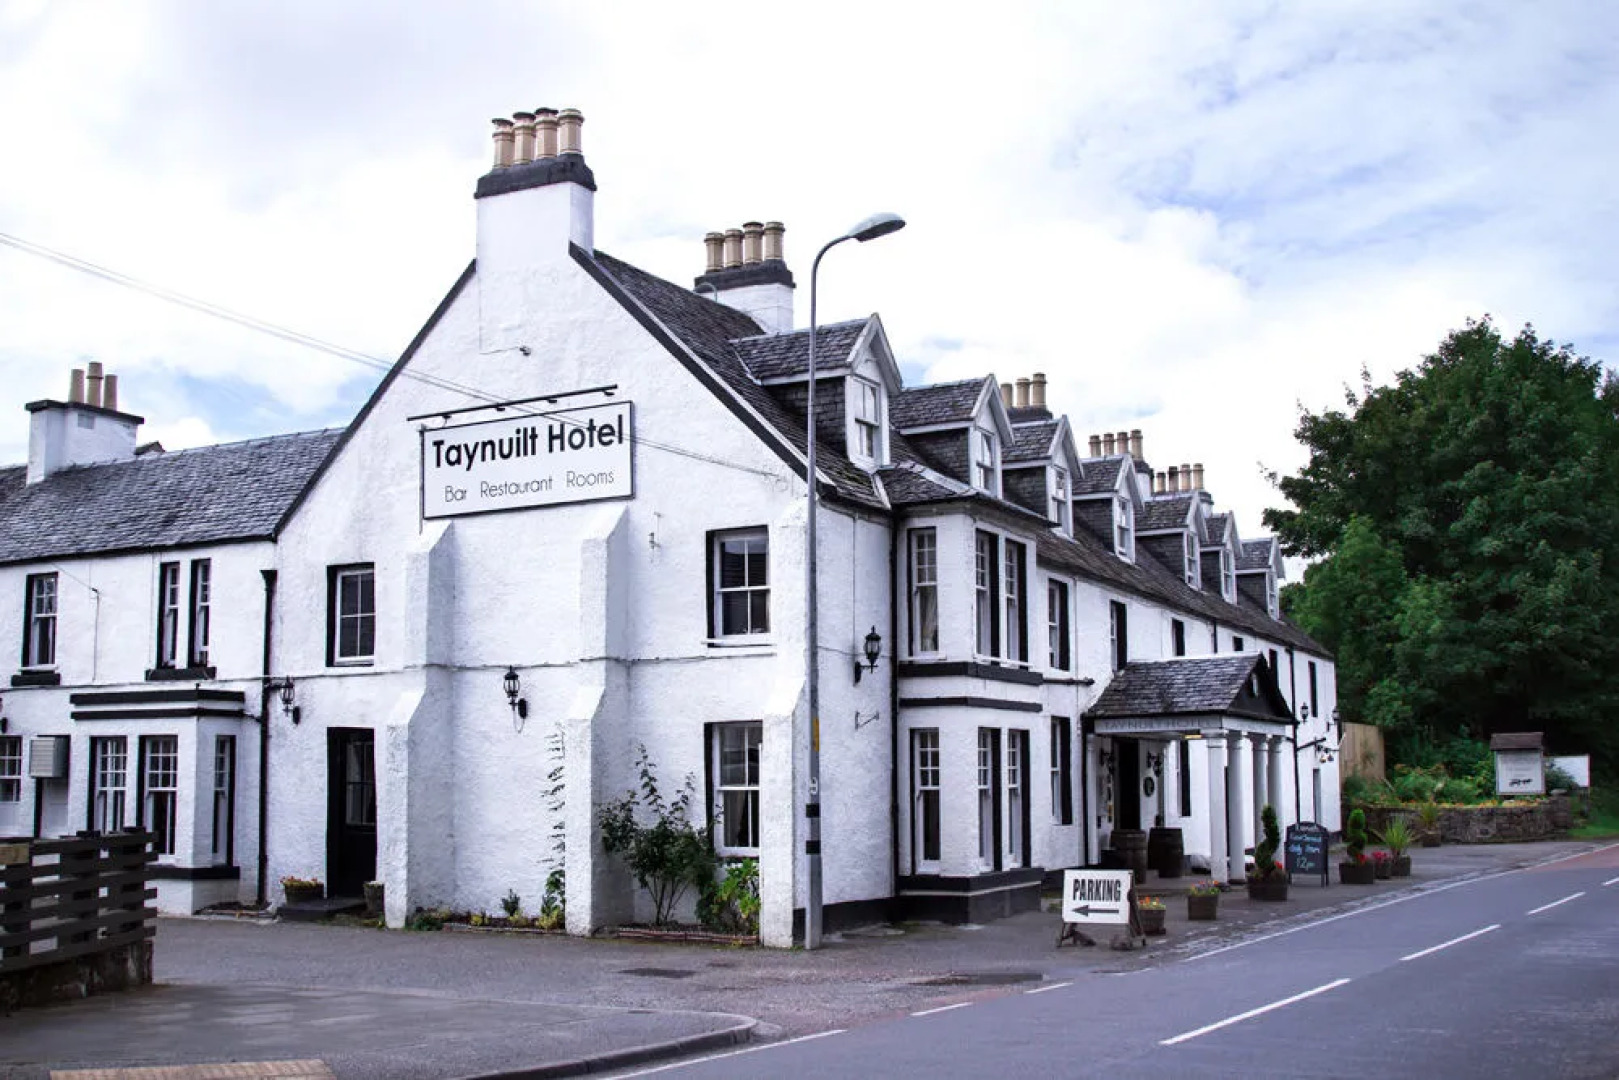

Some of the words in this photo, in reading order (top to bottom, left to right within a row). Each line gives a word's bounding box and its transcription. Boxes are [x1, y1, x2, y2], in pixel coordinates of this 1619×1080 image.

[432, 427, 538, 471] Taynuilt
[548, 414, 624, 453] Hotel
[444, 485, 467, 502] Bar
[480, 476, 553, 498] Restaurant
[566, 471, 615, 488] Rooms
[1073, 878, 1121, 902] PARKING
